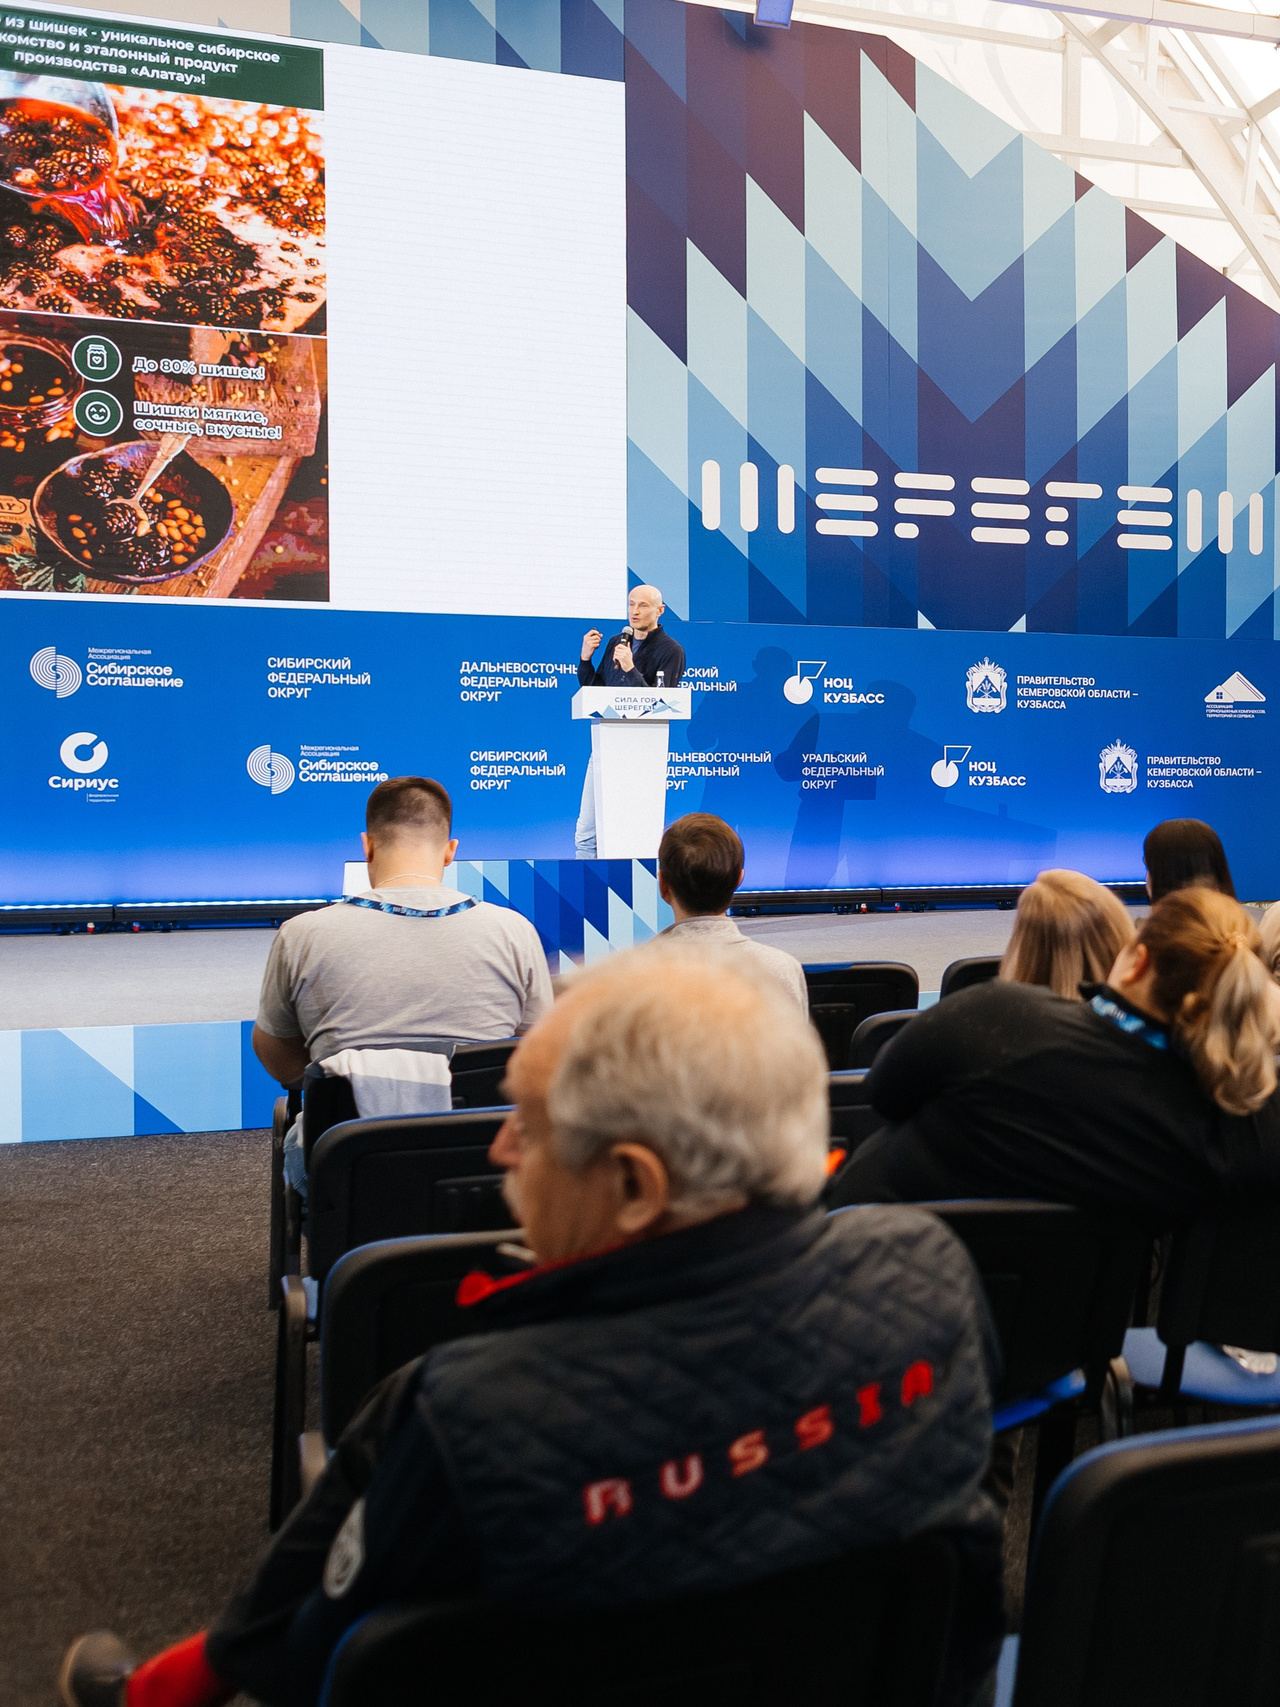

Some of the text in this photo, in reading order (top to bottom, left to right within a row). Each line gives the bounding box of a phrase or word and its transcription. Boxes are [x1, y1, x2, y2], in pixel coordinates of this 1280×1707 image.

[5, 16, 25, 29] из
[28, 19, 88, 38] шишек
[101, 28, 195, 52] уникальное
[197, 43, 281, 64] сибирское
[0, 32, 239, 76] комство и эталонный продукт
[14, 50, 207, 86] производства «Алатау»!
[132, 356, 266, 380] До 80% шишек!
[133, 400, 269, 425] Шишки мягкие,
[133, 418, 283, 440] сочные, вкусные!
[86, 662, 173, 677] Сибирское
[267, 656, 352, 670] СИБИРСКИЙ
[86, 674, 184, 688] Соглашение
[267, 671, 371, 687] ФЕДЕРАЛЬНЫЙ
[460, 675, 558, 689] ФЕДЕРАЛЬНЫЙ
[824, 678, 853, 690] НОЦ
[1017, 675, 1096, 687] ПРАВИТЕЛЬСТВО
[267, 687, 312, 699] ОКРУГ
[460, 690, 502, 702] ОКРУГ
[823, 692, 885, 705] КУЗБАСС
[1017, 687, 1086, 699] КЕМЕРОВСКОЙ
[1087, 690, 1131, 700] ОБЛАСТИ
[1017, 699, 1067, 710] КУЗБАССА
[470, 750, 547, 763] СИБИРСКИЙ
[667, 750, 772, 763] ЛЬНЕВОСТОЧНЫЙ
[802, 751, 867, 763] УРАЛЬСКИЙ
[1147, 756, 1221, 766] ПРАВИТЕЛЬСТВО
[299, 759, 379, 772] Сибирское
[470, 764, 566, 777] ФЕДЕРАЛЬНЫЙ
[666, 766, 740, 778] ДЕРАЛЬНЫЙ
[802, 765, 884, 777] ФЕДЕРАЛЬНЫЙ
[969, 761, 997, 773] НОЦ
[1147, 766, 1212, 777] КЕМЕРОВСКОЙ
[1213, 768, 1254, 777] ОБЛАСТИ
[48, 775, 119, 791] Сириус
[299, 771, 389, 783] Соглашение
[968, 776, 1027, 787] КУЗБАСС
[470, 779, 511, 791] ОКРУГ
[802, 779, 837, 790] ОКРУГ
[1147, 779, 1194, 789] КУЗБАССА
[583, 1360, 934, 1526] RUSSIA
